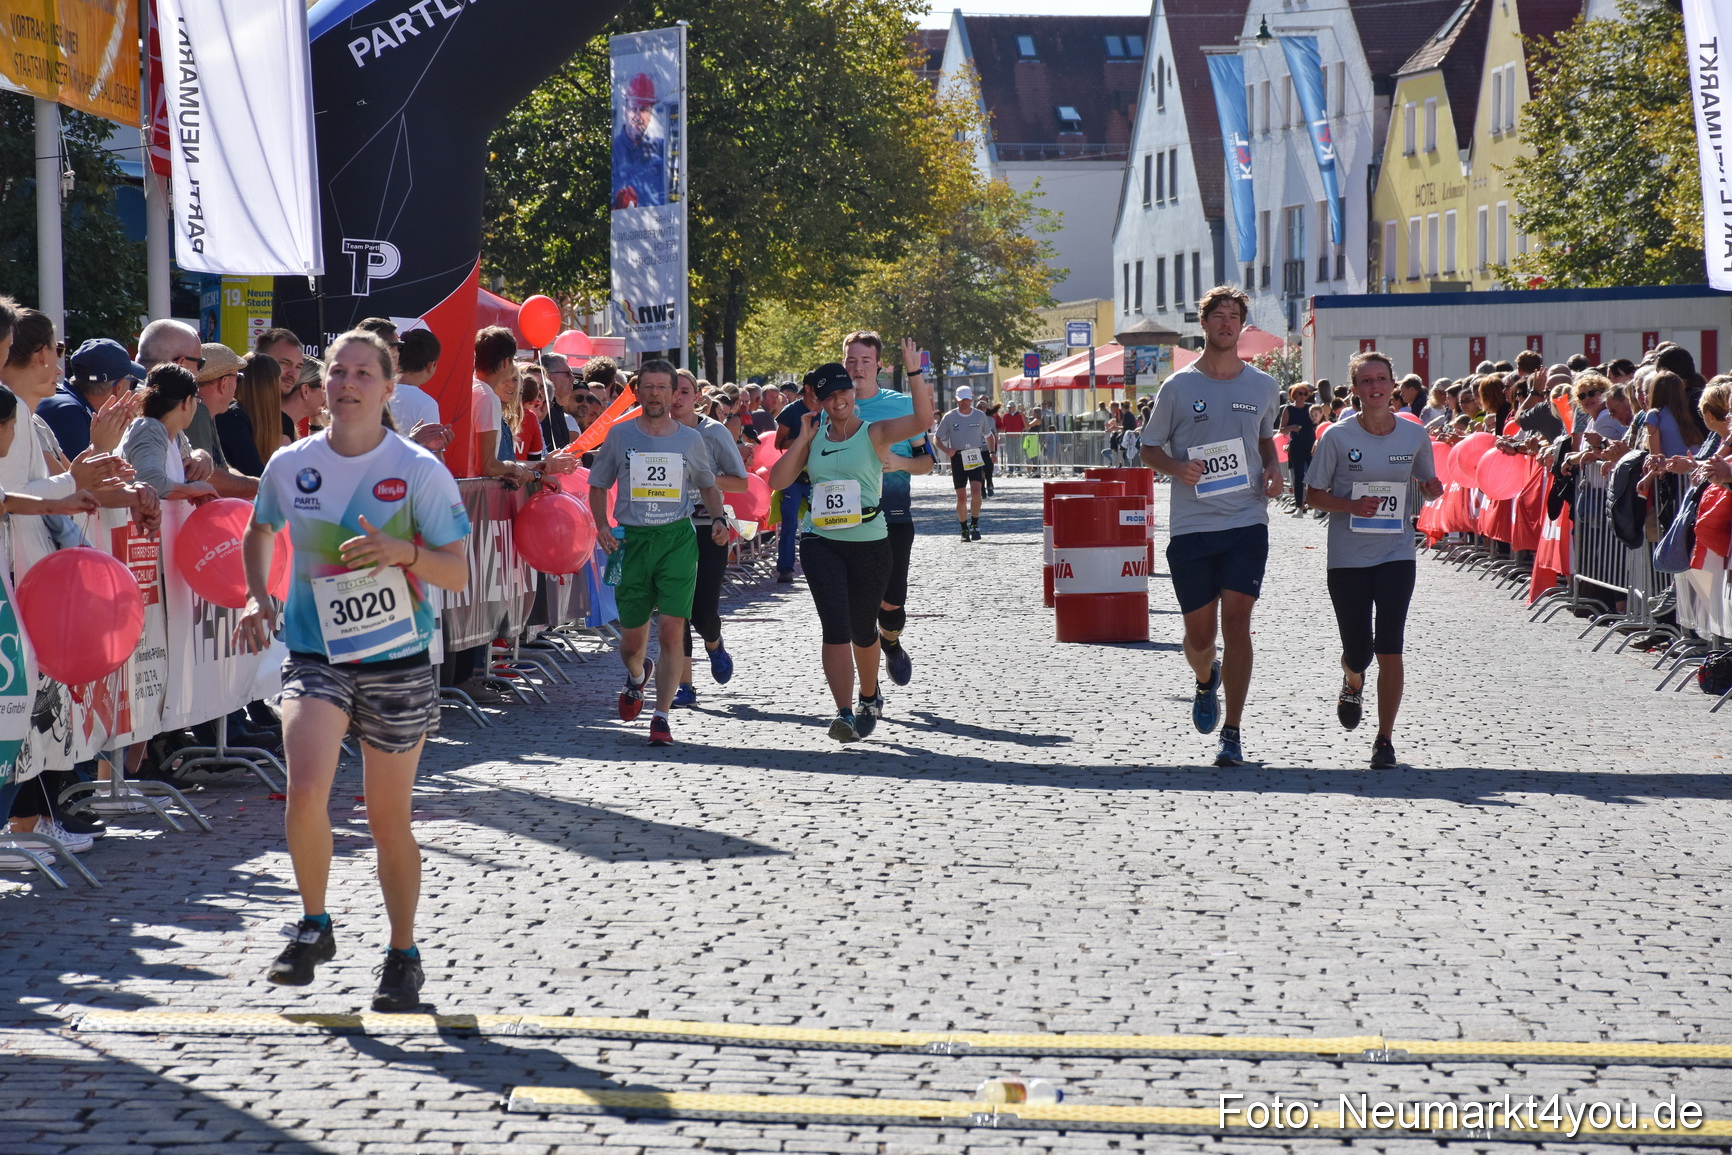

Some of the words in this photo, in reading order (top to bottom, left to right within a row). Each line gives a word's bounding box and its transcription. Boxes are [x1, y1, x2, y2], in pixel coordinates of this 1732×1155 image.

[348, 0, 462, 68] PARTL
[1415, 182, 1437, 207] HOTEL
[224, 288, 246, 307] 19.
[1232, 402, 1257, 411] BOCK
[578, 412, 614, 451] DEHN
[1204, 445, 1228, 455] BOCK
[1202, 453, 1238, 475] 3033
[647, 466, 666, 481] 23
[294, 497, 321, 505] PARTL
[646, 502, 660, 512] 19.
[826, 494, 844, 509] 63
[824, 517, 848, 525] Sabrina
[1121, 556, 1148, 577] AVI
[337, 576, 377, 592] BOCK
[330, 587, 396, 626] 3020
[341, 626, 360, 635] PARTL
[361, 618, 388, 630] Neumarkt
[388, 642, 423, 660] Stadtlauf
[7, 702, 27, 715] GmbH
